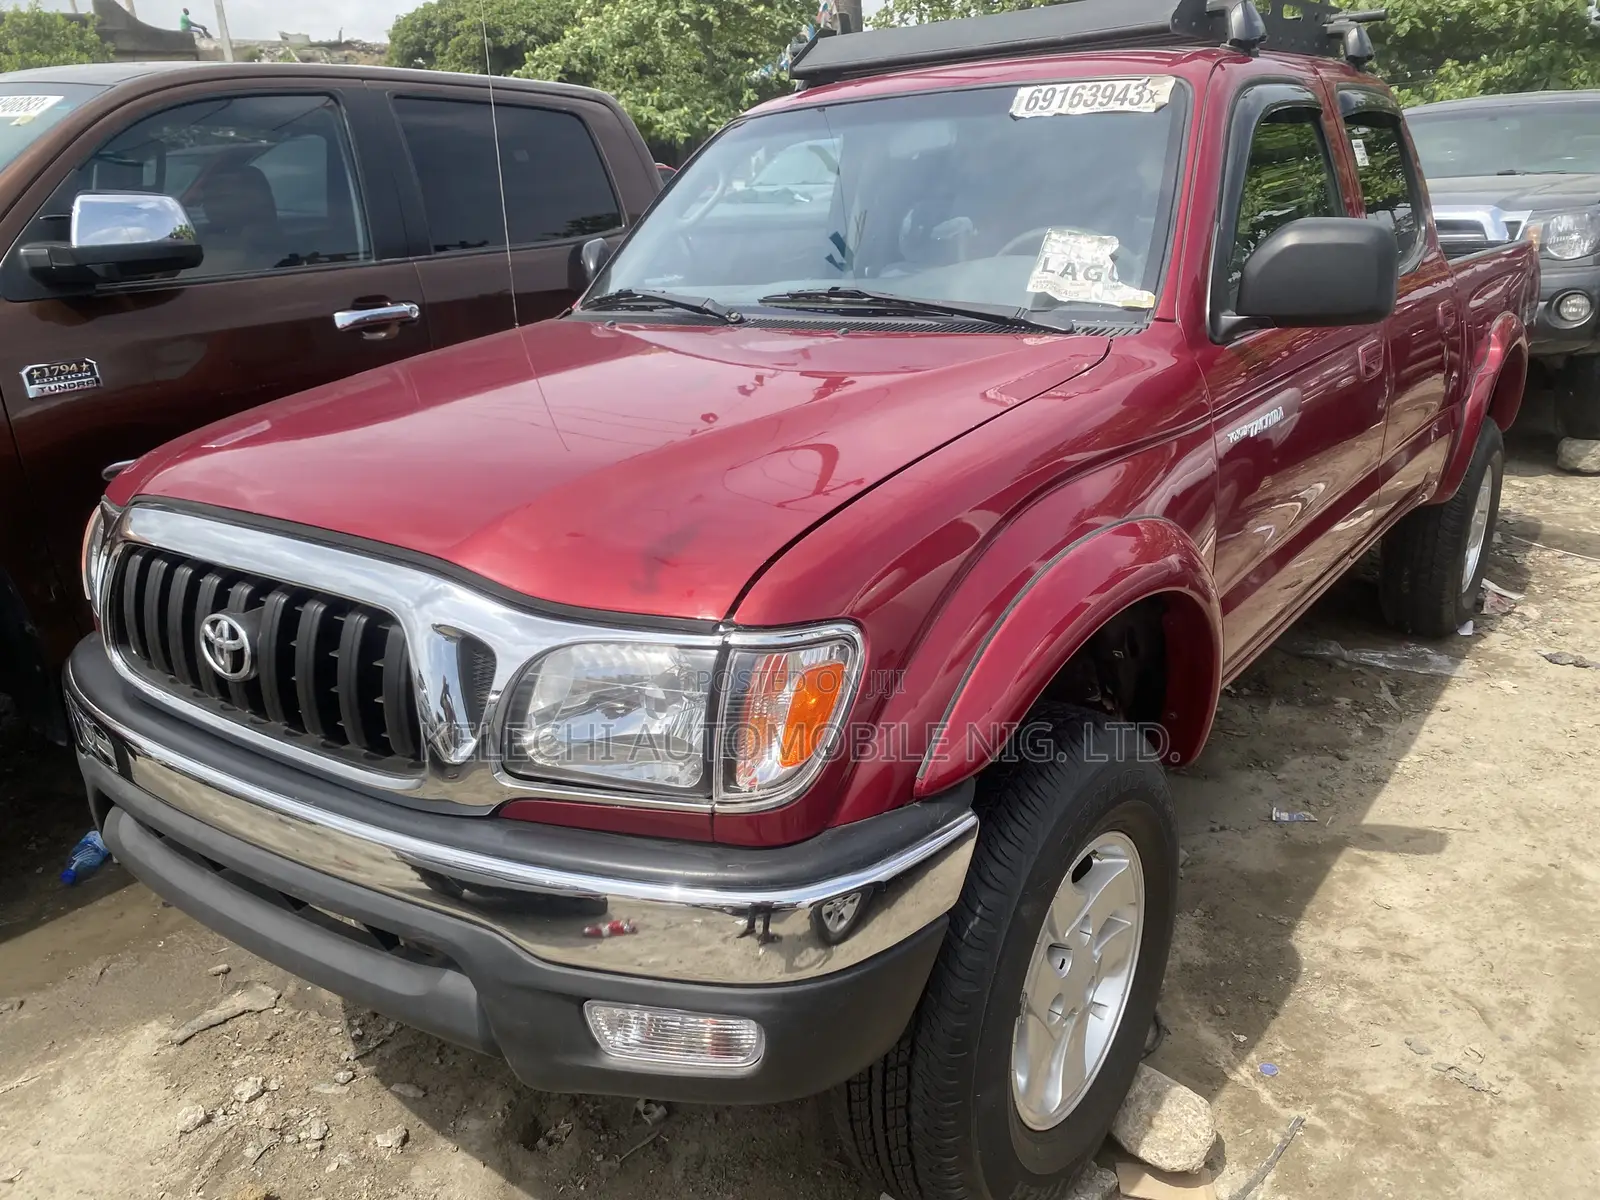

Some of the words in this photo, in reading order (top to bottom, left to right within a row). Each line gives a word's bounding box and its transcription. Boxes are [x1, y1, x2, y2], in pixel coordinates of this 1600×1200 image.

[42, 363, 79, 377] 1794
[34, 371, 91, 384] EDITION
[39, 379, 96, 393] TUNDRA
